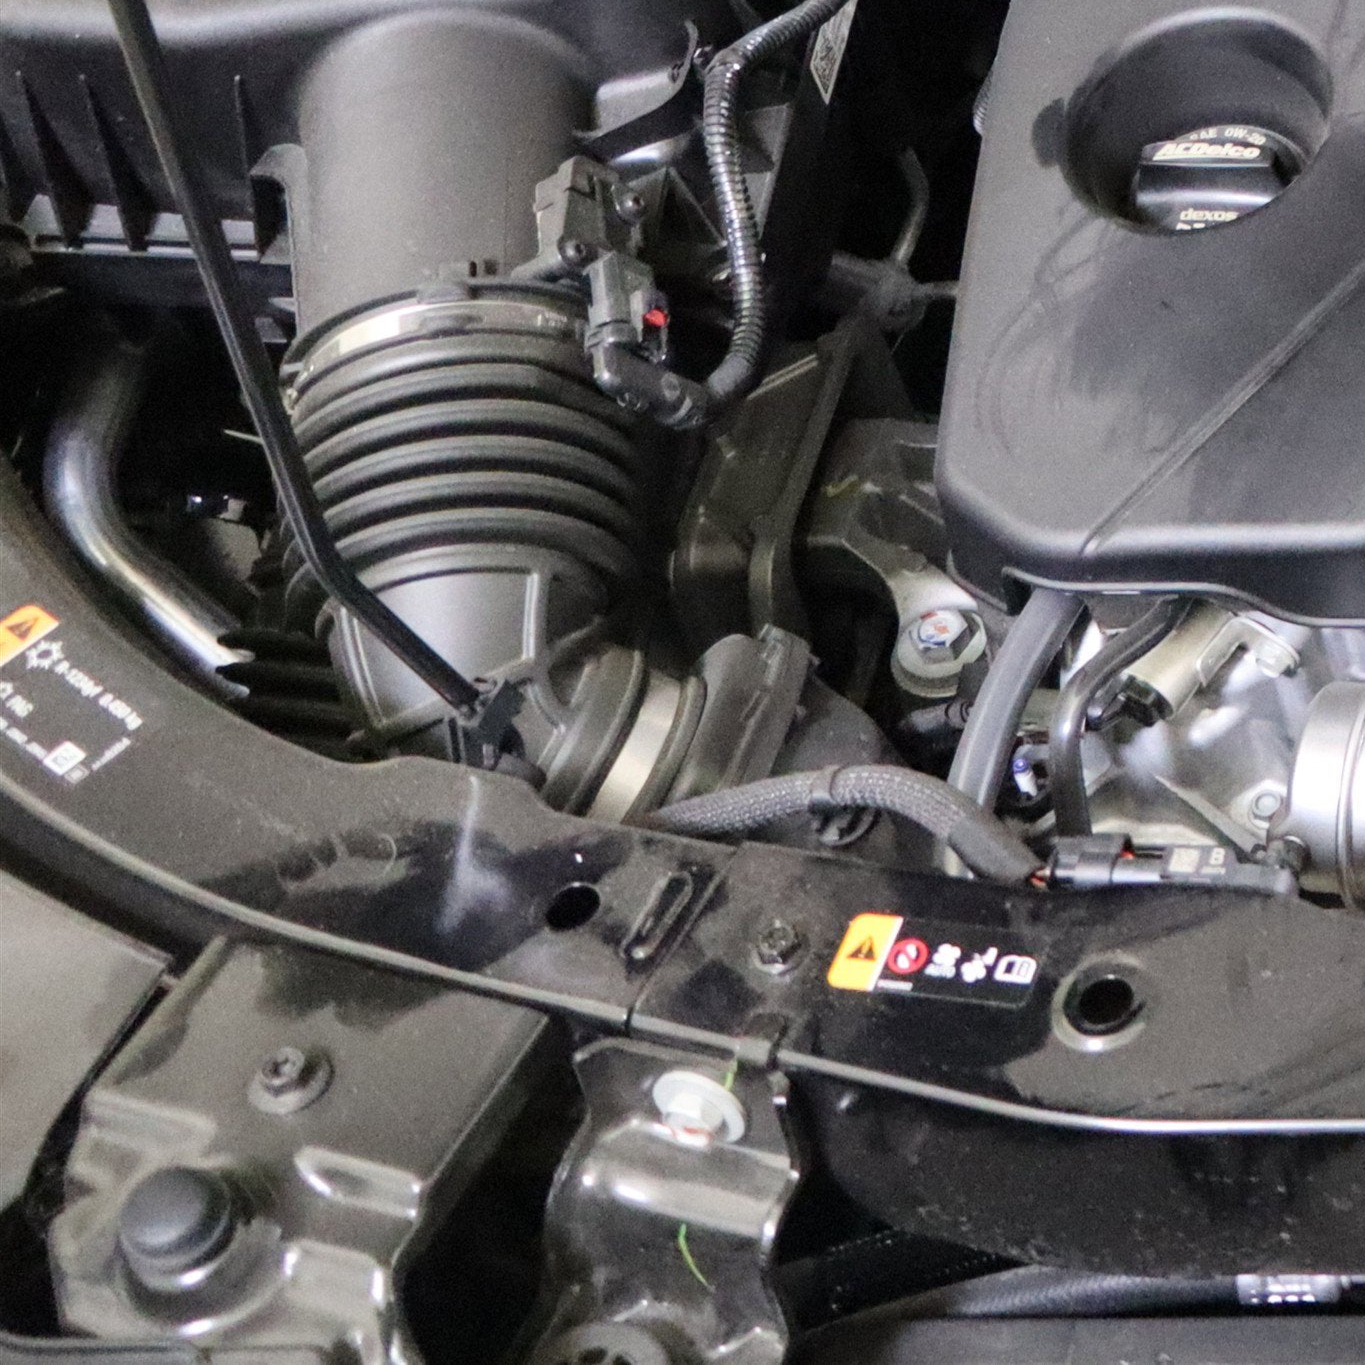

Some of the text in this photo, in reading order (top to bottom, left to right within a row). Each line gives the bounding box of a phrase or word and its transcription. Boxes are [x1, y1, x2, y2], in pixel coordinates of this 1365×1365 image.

[1224, 127, 1267, 146] 0W-20
[1153, 142, 1261, 161] ACDelco
[1180, 207, 1239, 222] dexos
